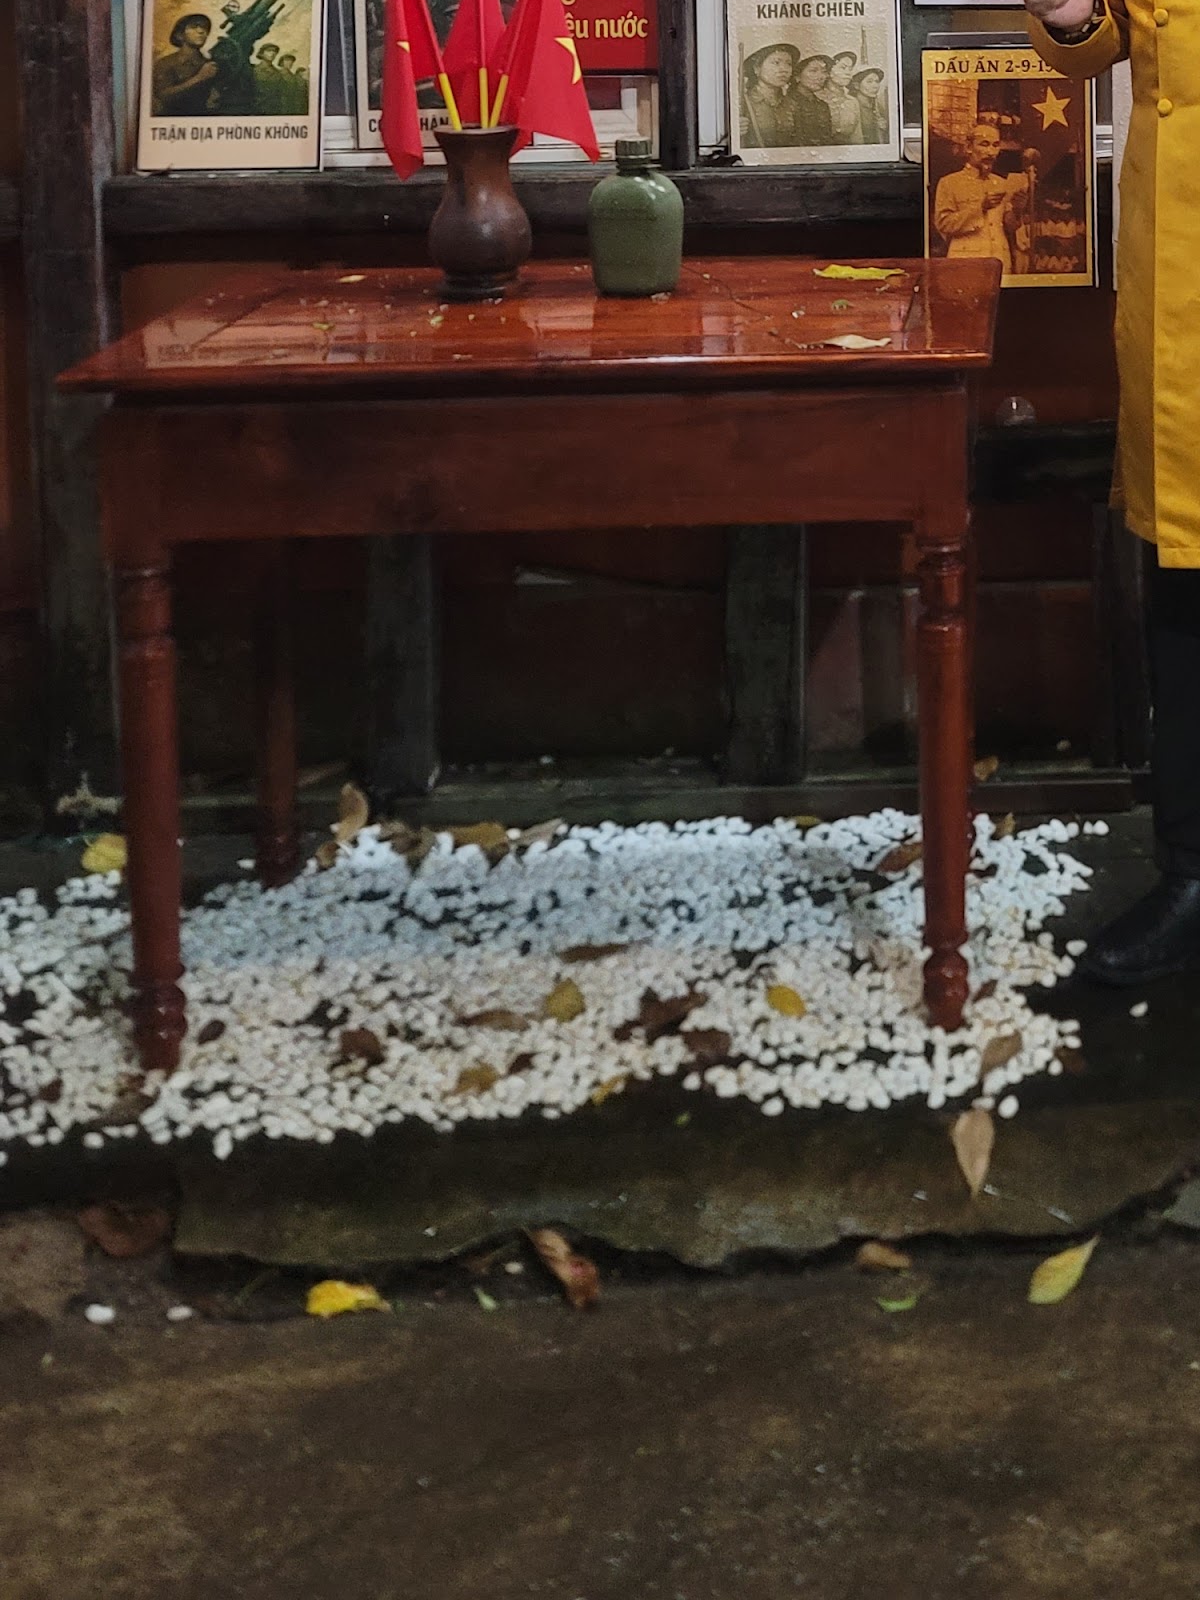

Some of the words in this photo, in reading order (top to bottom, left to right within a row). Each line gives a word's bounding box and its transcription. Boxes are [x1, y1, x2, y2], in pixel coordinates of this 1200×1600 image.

[757, 0, 812, 19] KHÁNG
[564, 11, 589, 38] êu
[595, 11, 648, 38] nước
[934, 56, 970, 73] DẤU
[974, 56, 999, 73] ẤN
[151, 127, 186, 143] TRẬN
[191, 127, 214, 143] ĐỊA
[217, 124, 261, 141] PHÒNG
[265, 122, 308, 140] KHÔNG
